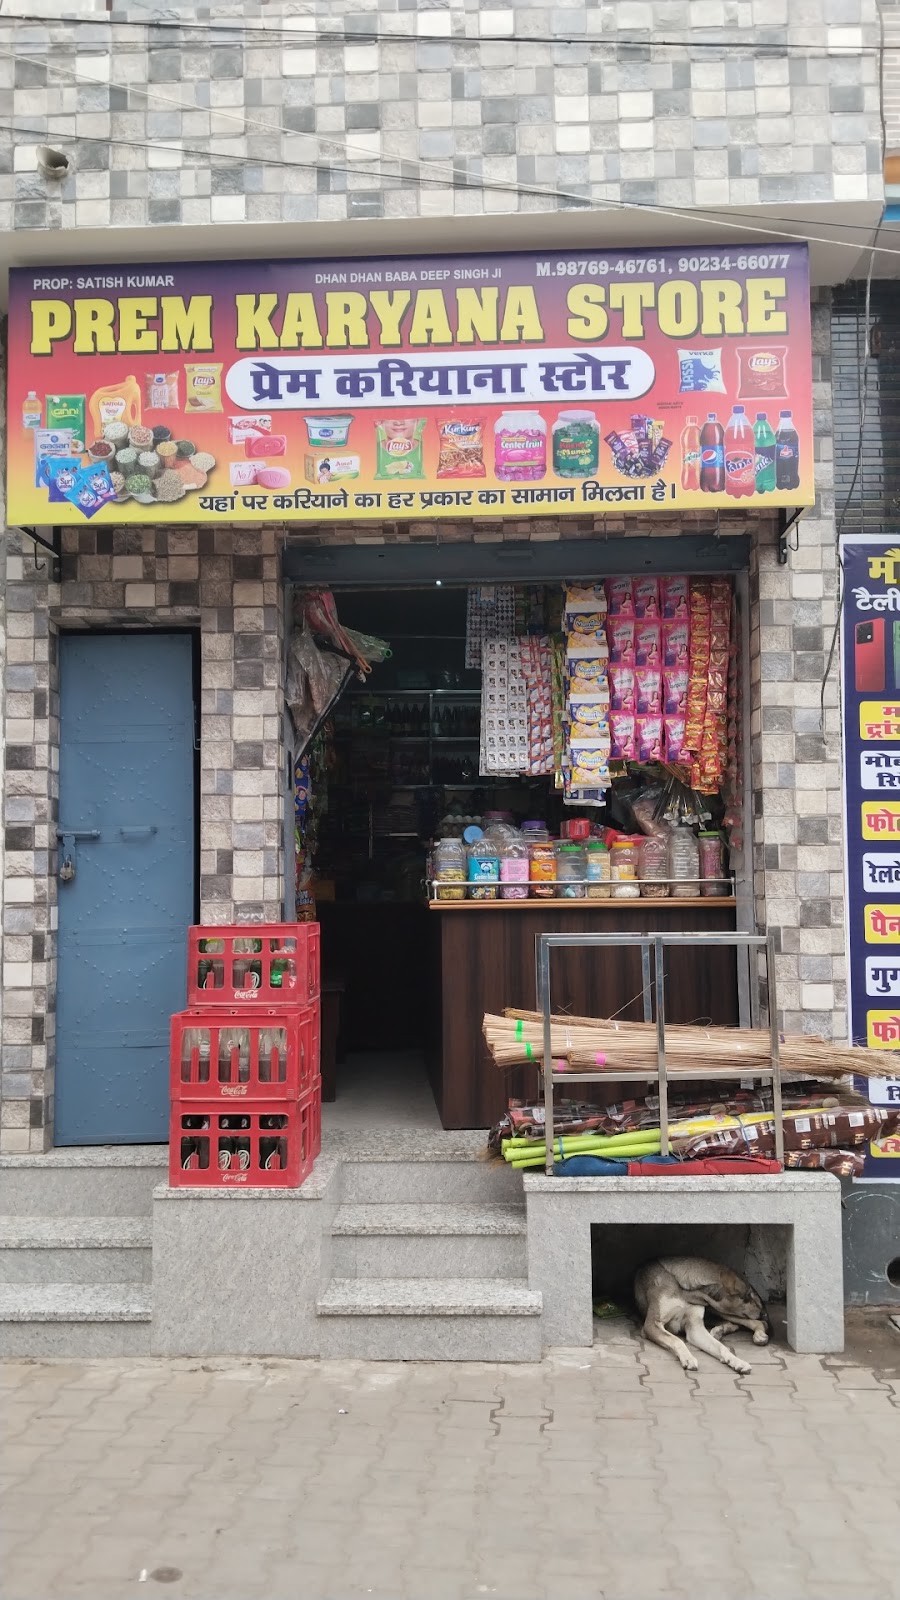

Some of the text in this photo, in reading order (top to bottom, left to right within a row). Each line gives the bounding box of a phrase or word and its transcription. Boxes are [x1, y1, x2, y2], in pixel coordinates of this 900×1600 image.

[315, 268, 502, 284] DHAN DHAN BABA DEEP SINGH JI
[535, 254, 790, 277] M.98769-46761, 90234-66077
[33, 275, 174, 290] PROP: SATISH KUMAR
[30, 277, 788, 356] PREM KARYANA STORE
[250, 353, 631, 401] प्रेम करियाना स्टोर
[199, 490, 239, 512] यहां
[242, 495, 269, 511] पर
[272, 488, 349, 509] करियाने
[354, 493, 382, 508] का
[387, 492, 415, 509] हर
[419, 491, 473, 509] प्रकार
[478, 489, 506, 505] का
[511, 487, 576, 504] सामान
[581, 480, 646, 502] मिलता
